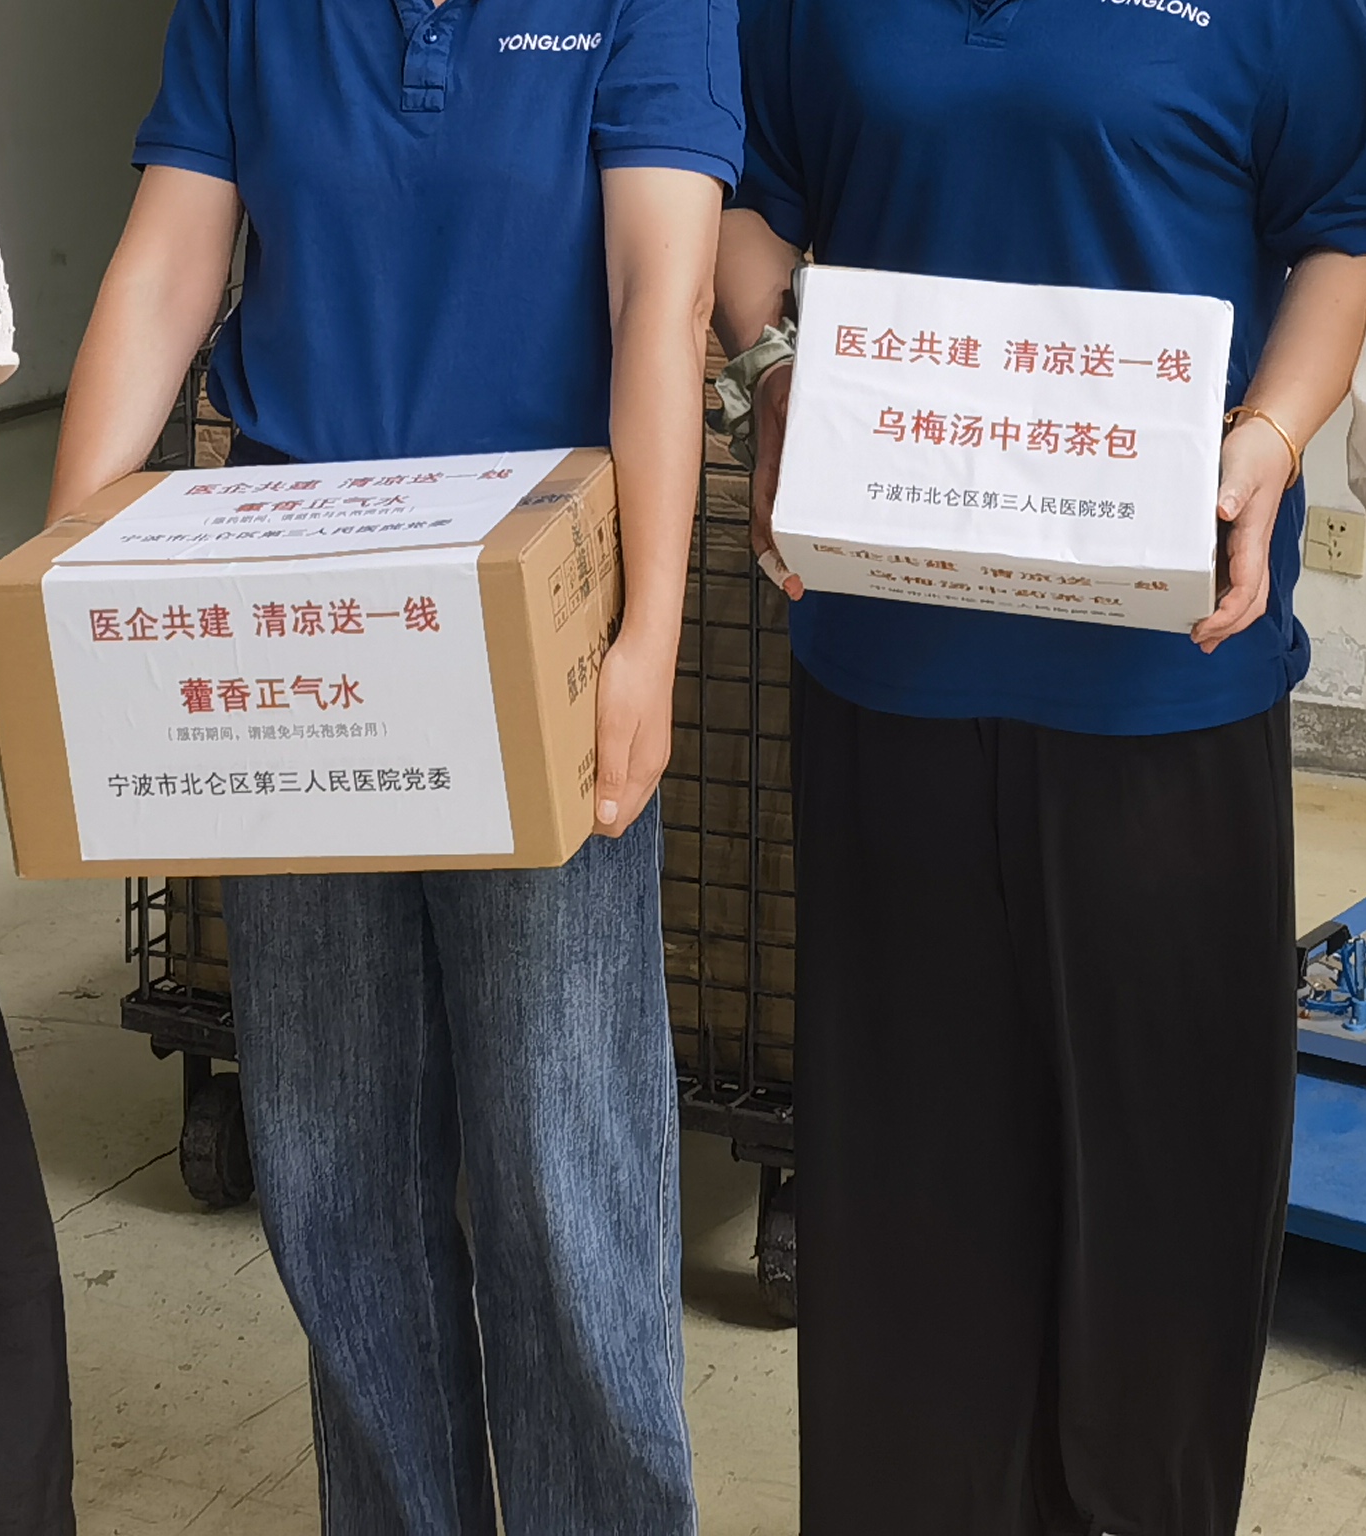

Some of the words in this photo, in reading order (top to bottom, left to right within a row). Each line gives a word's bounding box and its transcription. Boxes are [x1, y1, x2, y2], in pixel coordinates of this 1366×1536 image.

[498, 32, 602, 53] YONGLONG
[835, 324, 983, 369] 医企共建
[1003, 339, 1192, 384] 清凉送一线
[872, 406, 1139, 460] 乌梅汤中药茶包
[866, 481, 1137, 521] 宁波市北仑区第三人民医院党委
[89, 603, 235, 643] 医企共建
[251, 595, 441, 639] 清凉送一线
[179, 673, 365, 715] 藿香正气水
[107, 766, 453, 798] 宁波市北仑区第三人民医院党委
